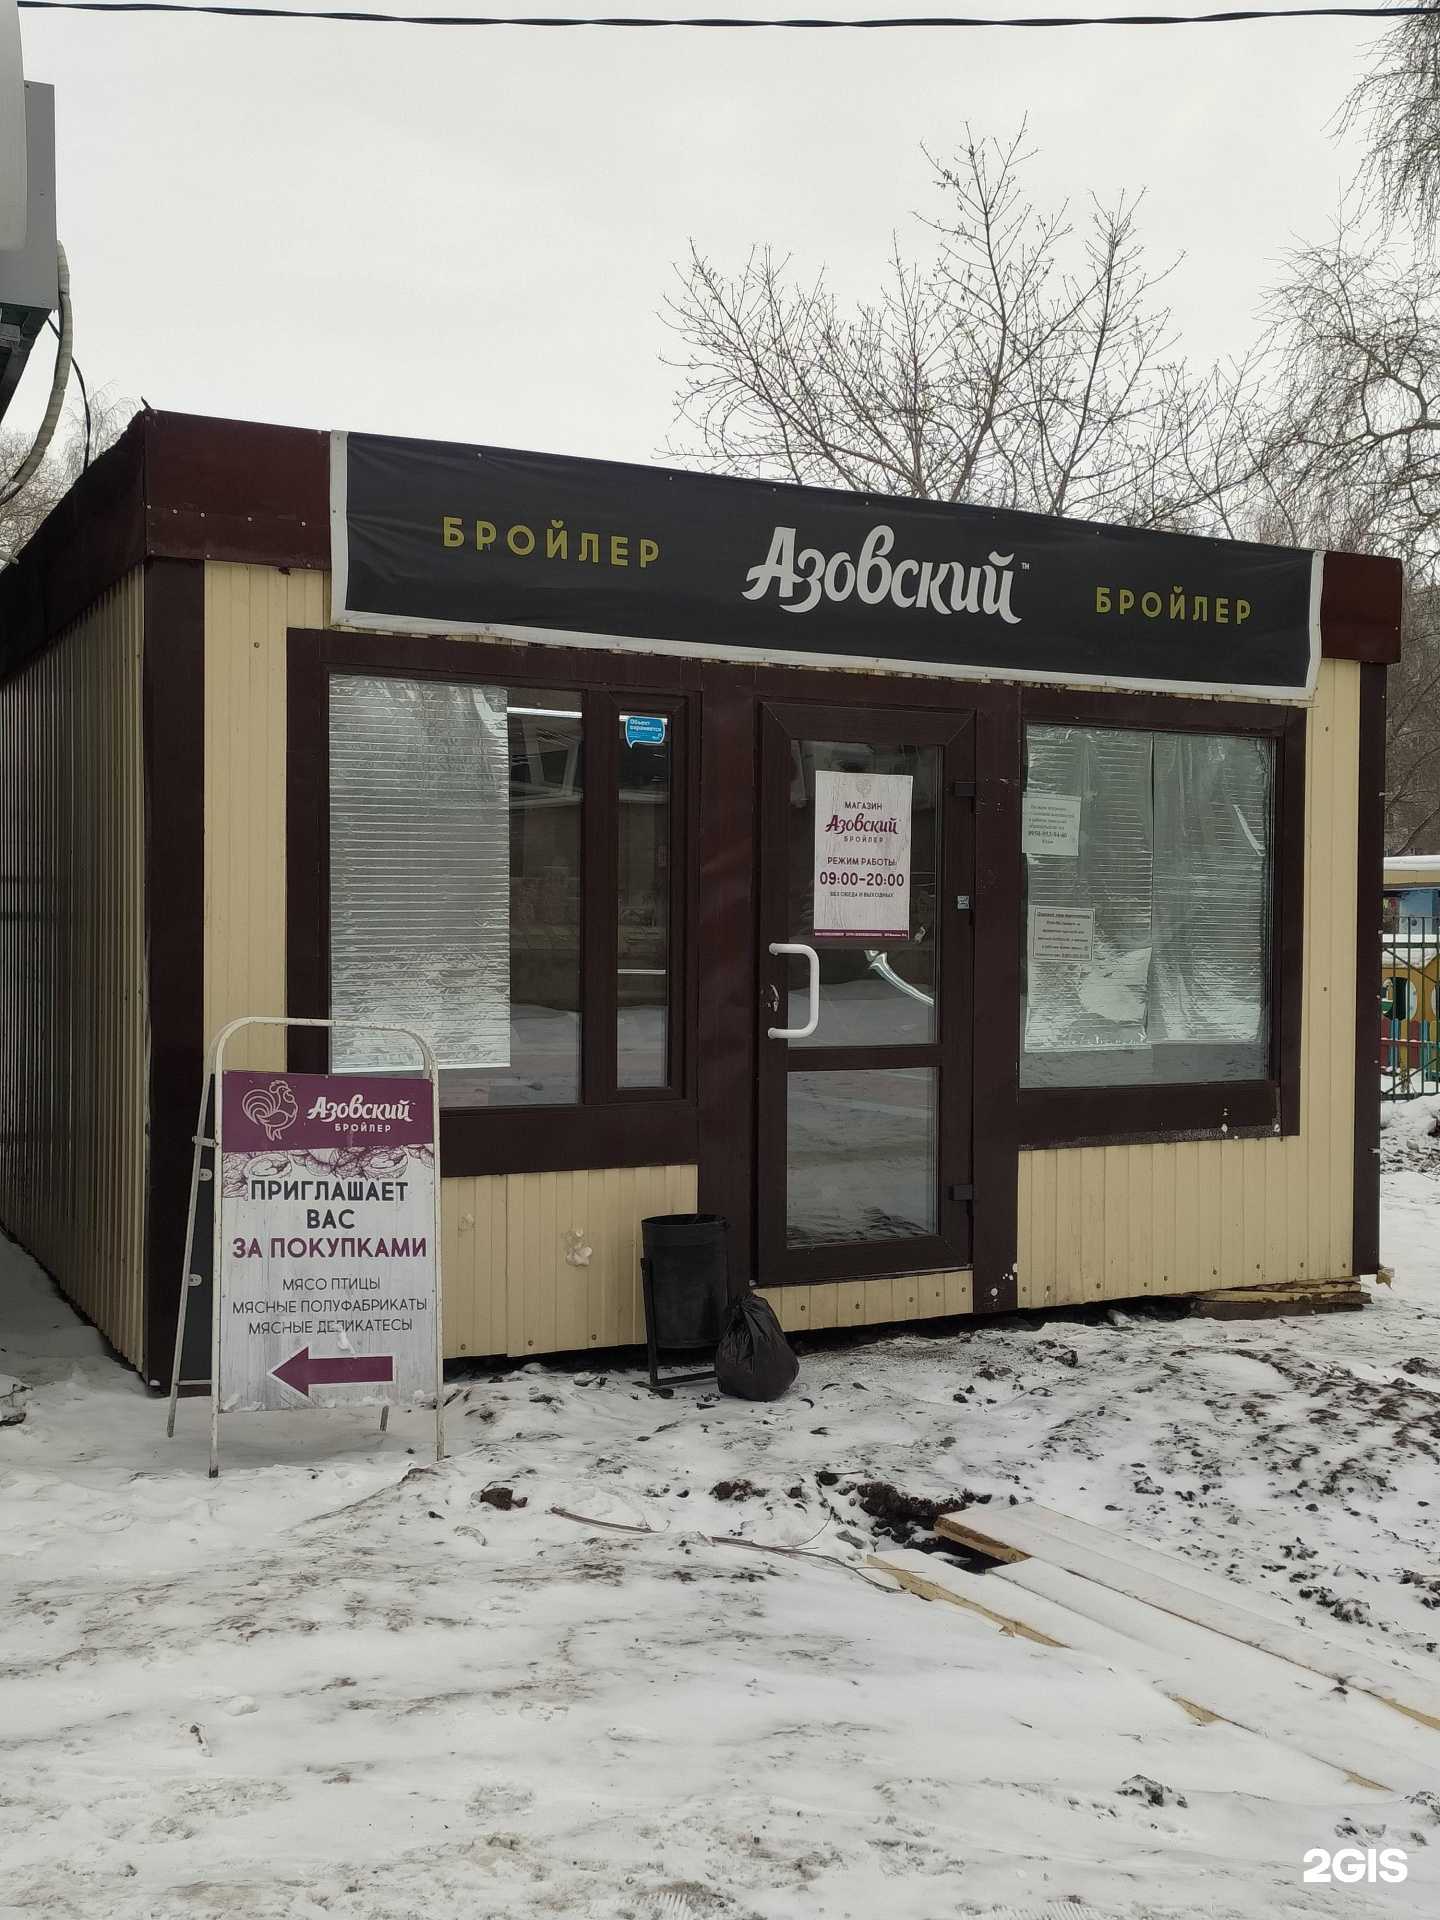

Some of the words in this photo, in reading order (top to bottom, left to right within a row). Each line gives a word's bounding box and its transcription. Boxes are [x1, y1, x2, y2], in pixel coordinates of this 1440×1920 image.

[442, 516, 660, 569] БРОЙЛЕР
[741, 524, 1022, 625] Азовский
[1096, 585, 1252, 625] БРОЙЛЕР
[844, 801, 883, 811] МАГАЗИН
[825, 812, 899, 835] Азовский
[827, 856, 859, 866] РЕЖИМ
[306, 1094, 414, 1123] Азовский
[334, 1122, 392, 1133] БРОЙЛЕР
[250, 1180, 409, 1202] ПРИГЛАШАЕТ
[306, 1208, 355, 1230] ВАС
[232, 1237, 262, 1259] ЗА
[270, 1237, 427, 1259] ПОКУПКАМИ
[282, 1278, 327, 1291] МЯСО
[331, 1277, 381, 1291] ПТИЦЫ
[232, 1300, 297, 1314] МЯСНЫЕ
[300, 1298, 428, 1313] ПОЛУФАБРИКАТЫ
[248, 1321, 313, 1335] МЯСНЫЕ
